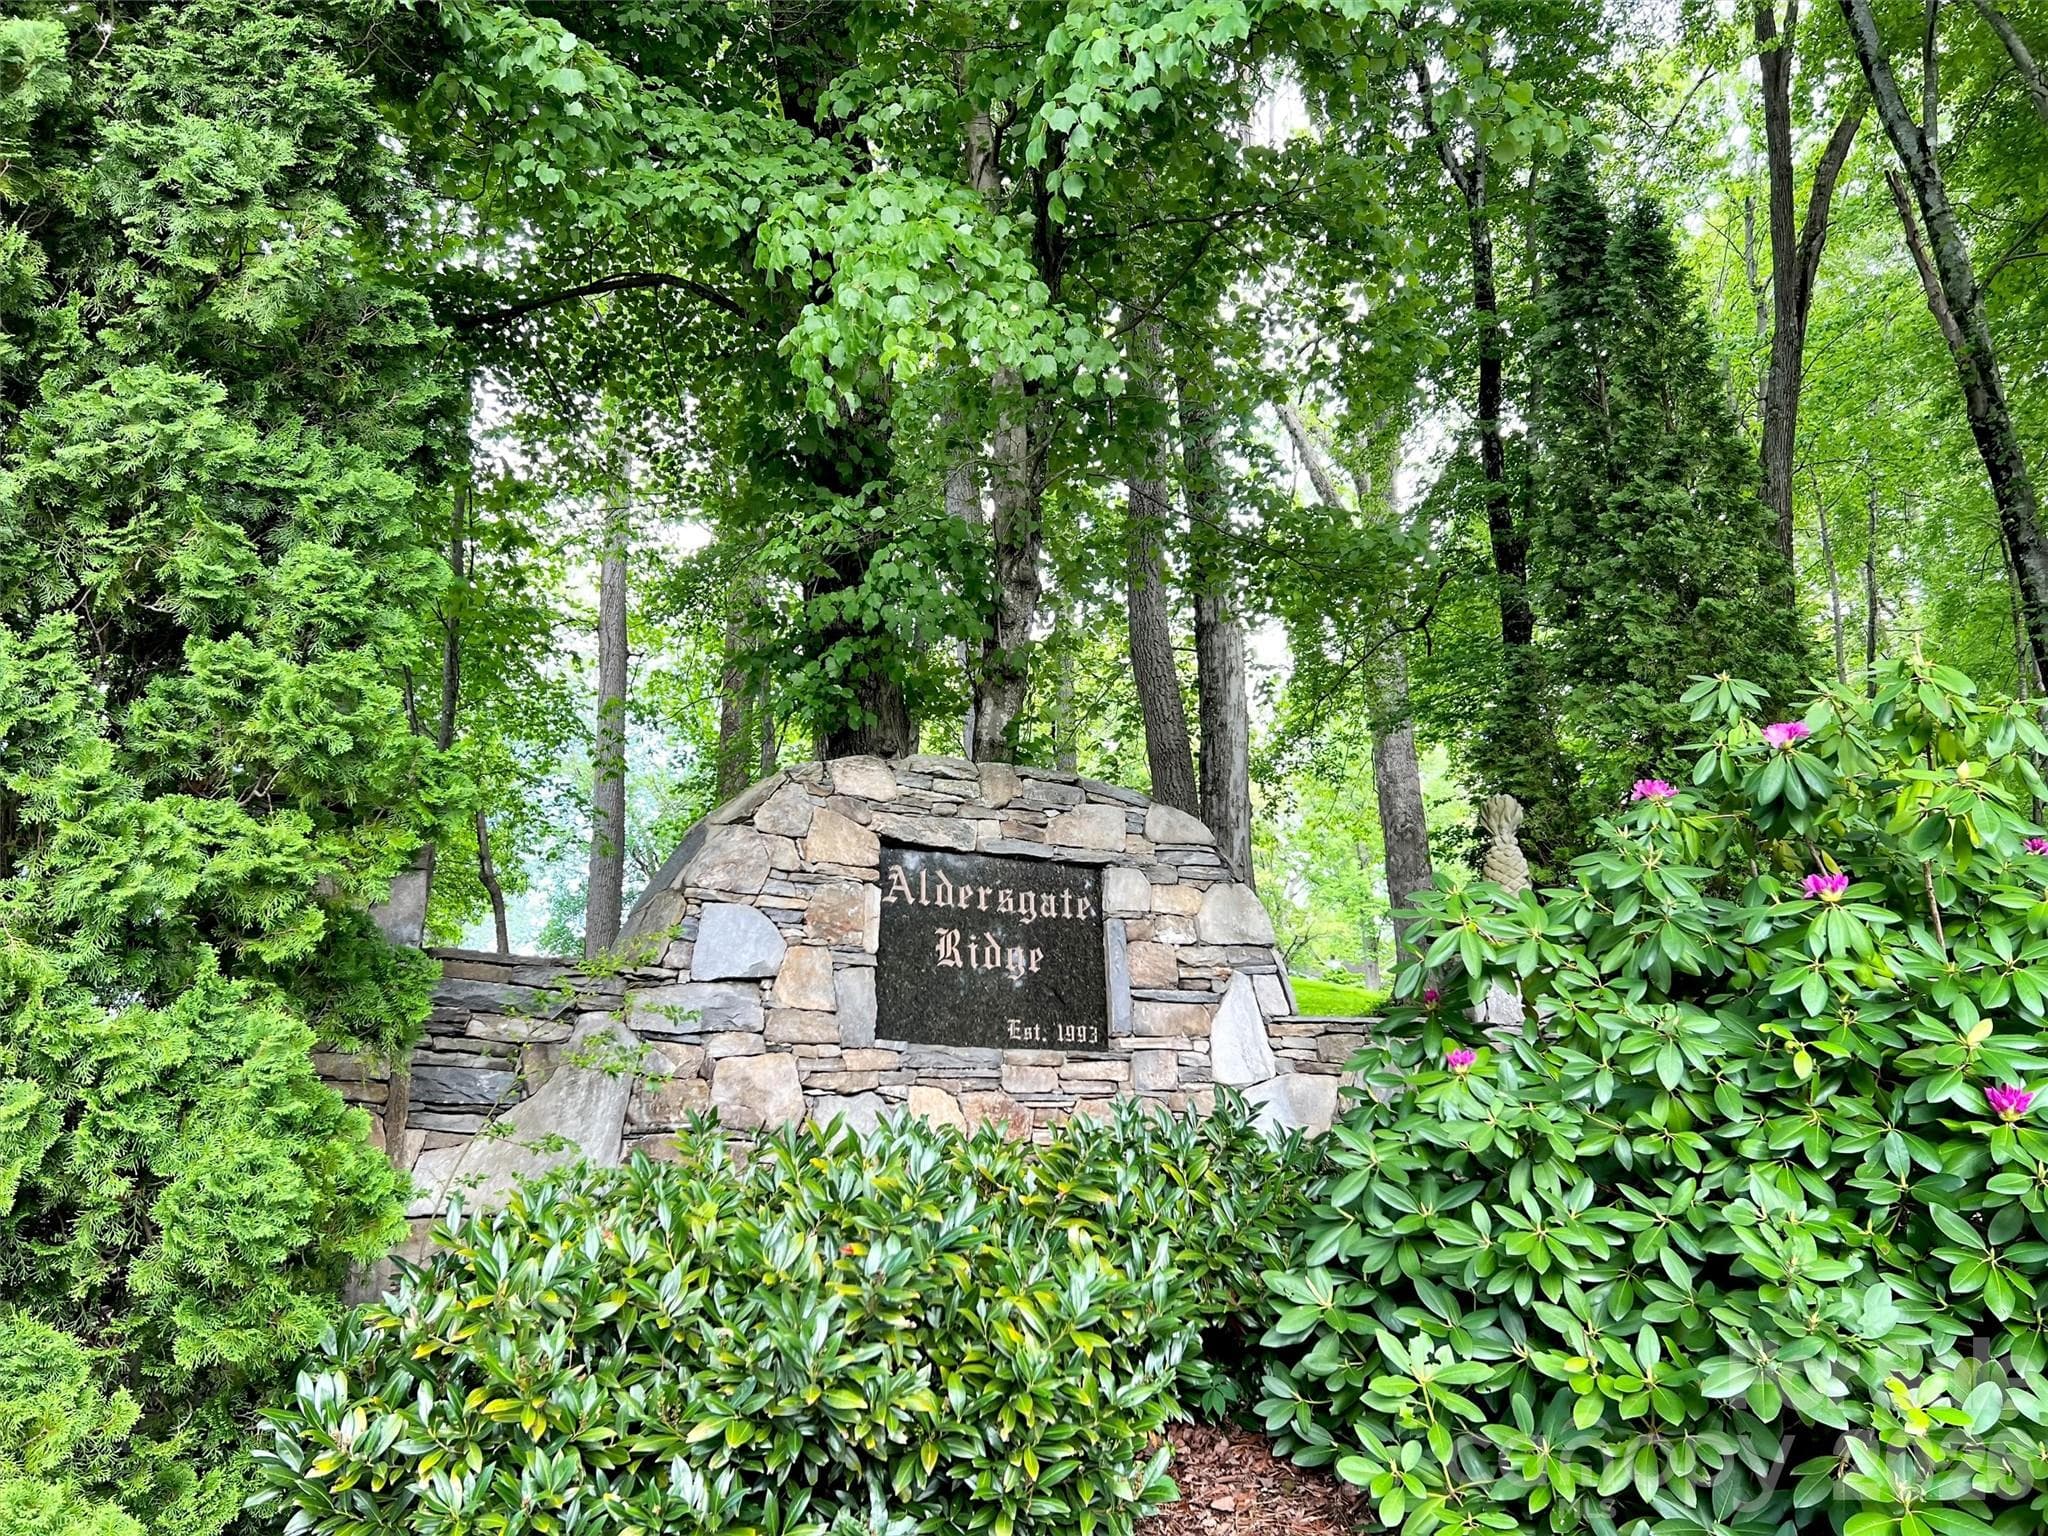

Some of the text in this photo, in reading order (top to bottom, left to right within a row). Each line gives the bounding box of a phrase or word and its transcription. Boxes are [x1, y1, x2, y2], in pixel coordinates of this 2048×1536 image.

[882, 864, 1093, 924] Aldersgate
[935, 928, 1044, 980] Ridge
[1007, 1019, 1098, 1043] Est. 1993
